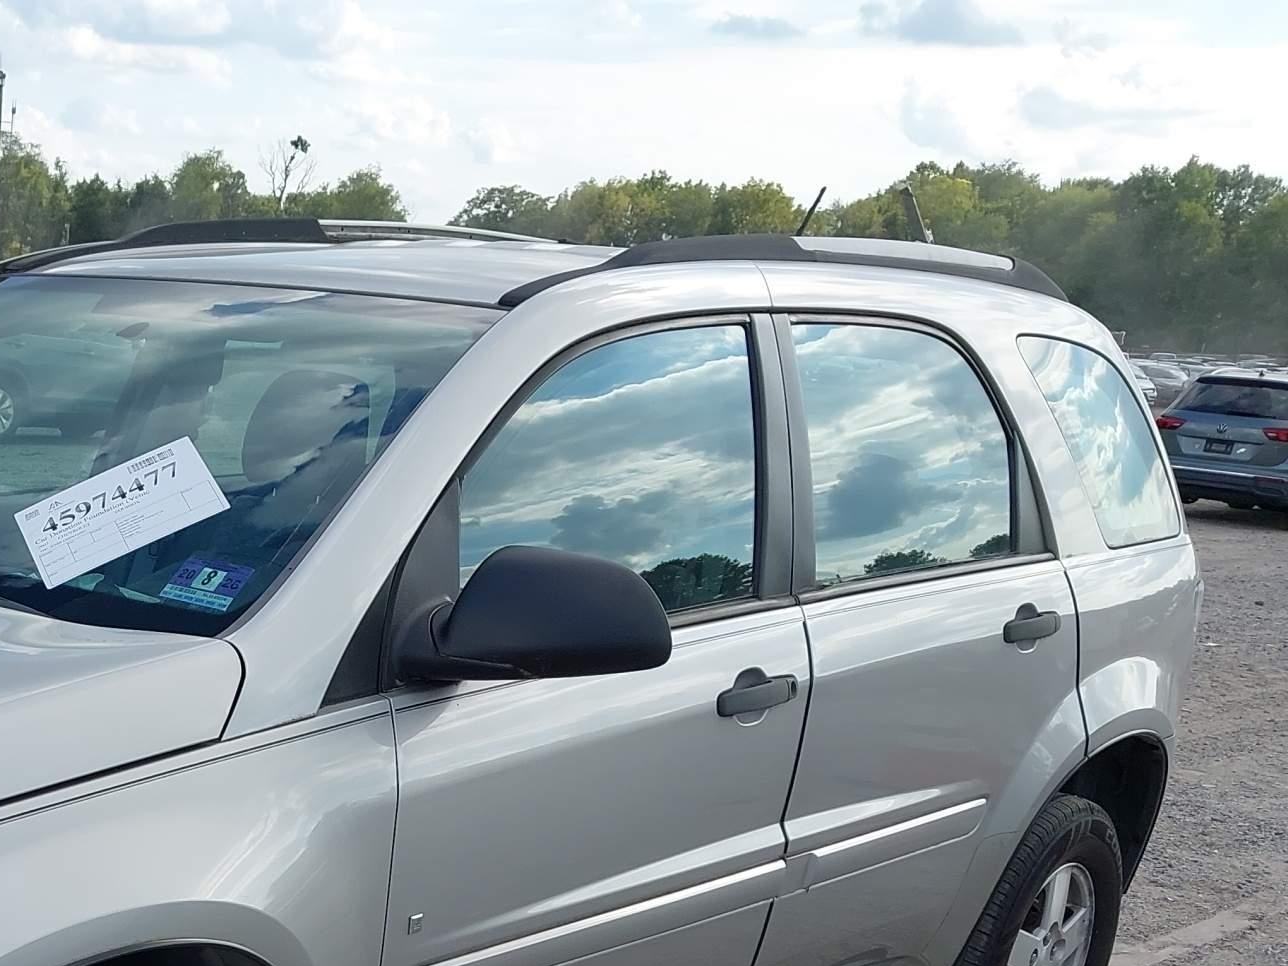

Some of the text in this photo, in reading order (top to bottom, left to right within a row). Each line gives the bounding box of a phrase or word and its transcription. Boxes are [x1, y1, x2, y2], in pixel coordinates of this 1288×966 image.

[42, 461, 176, 533] 45974477
[177, 567, 197, 580] 20
[200, 570, 219, 586] 8
[221, 577, 242, 590] 26
